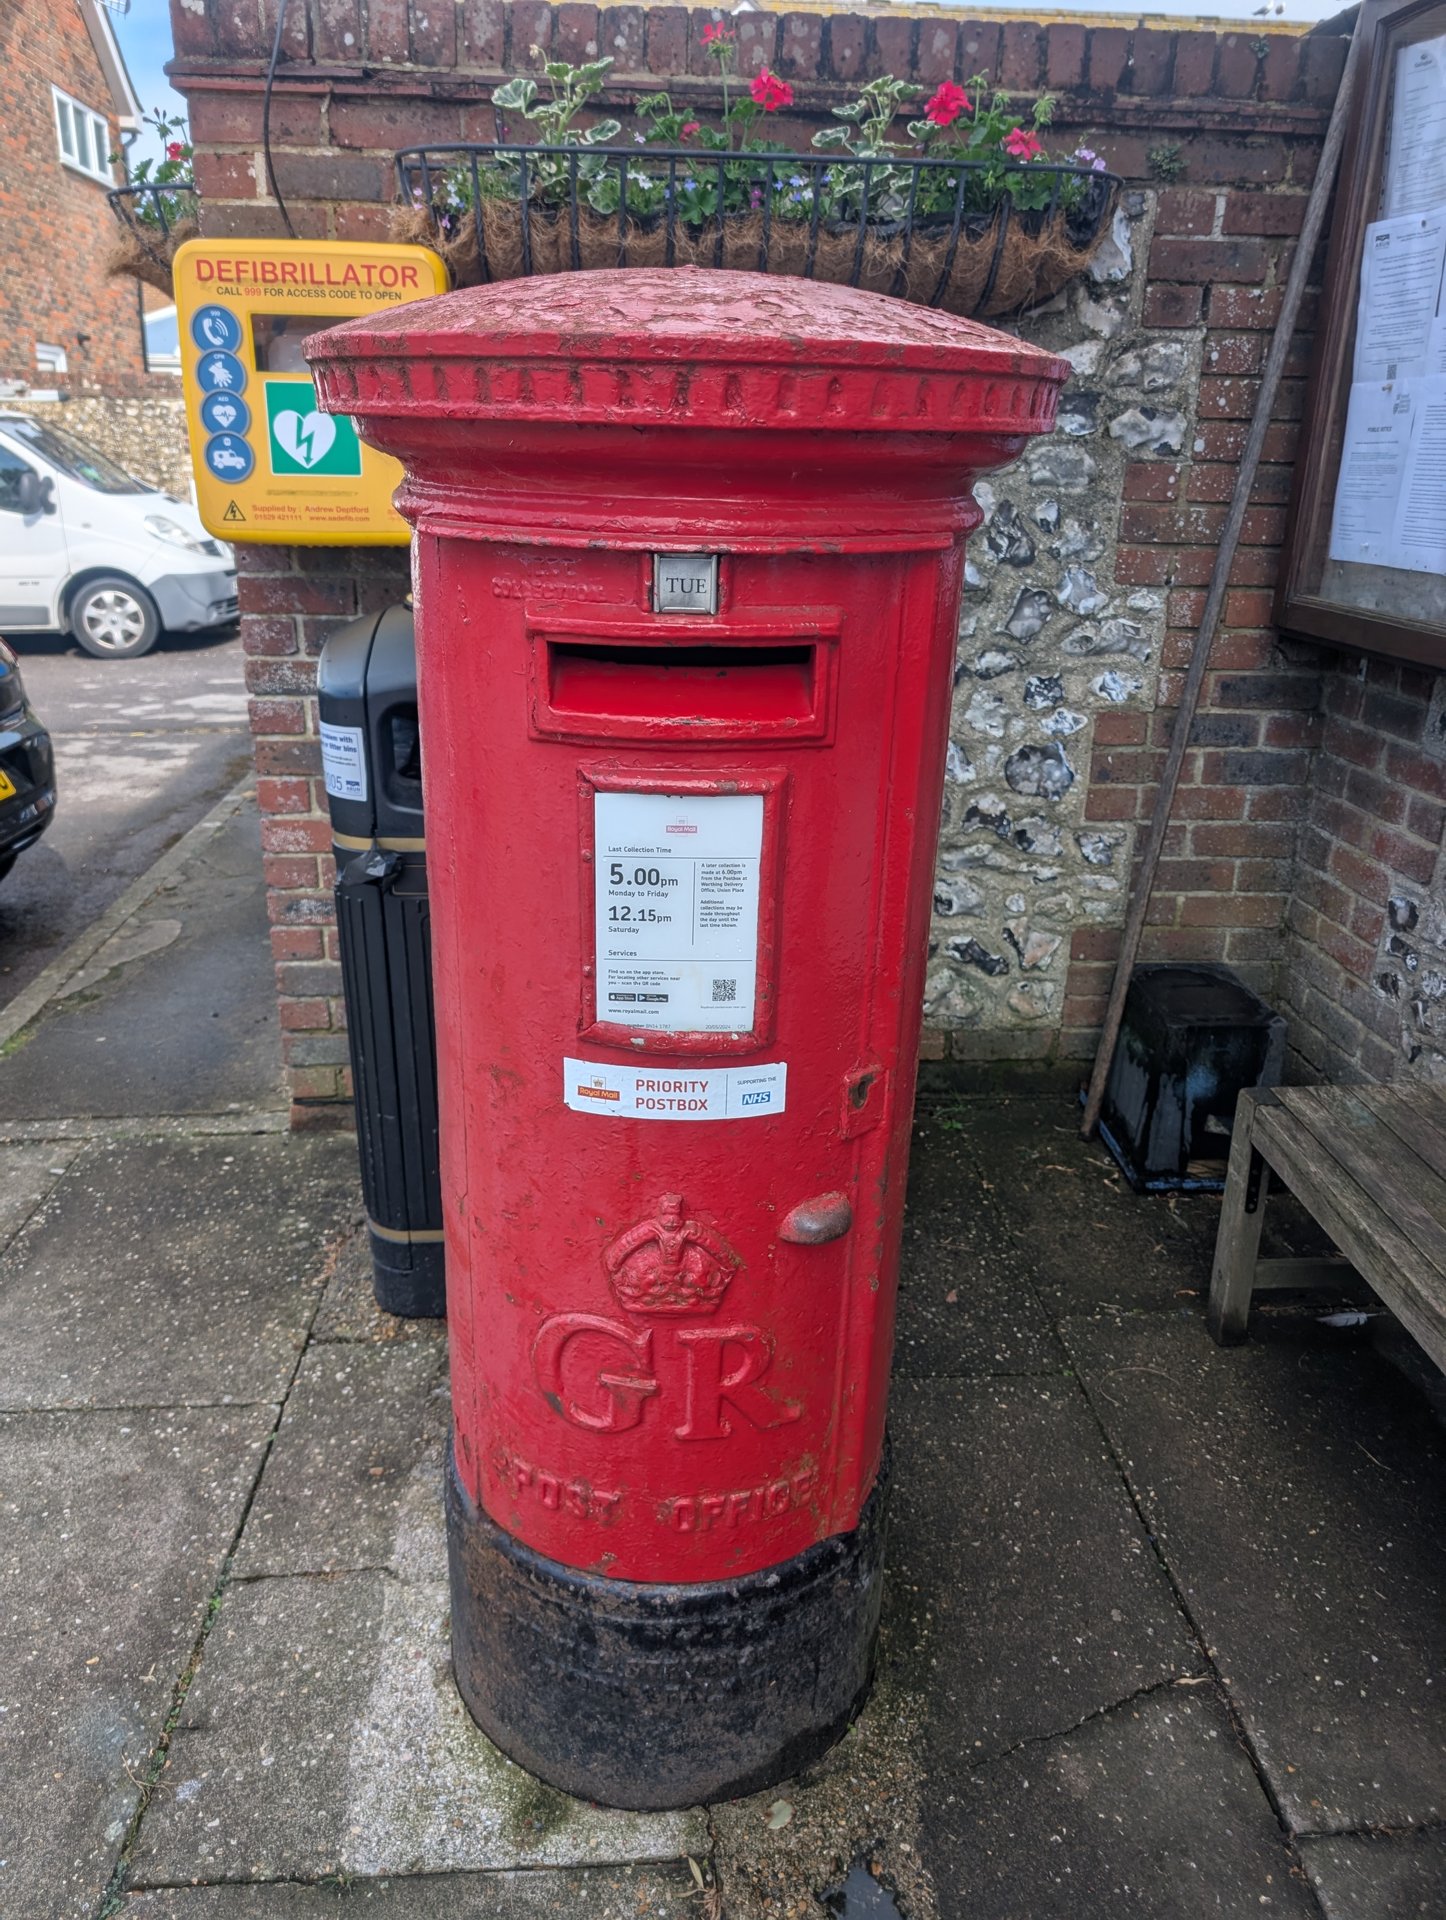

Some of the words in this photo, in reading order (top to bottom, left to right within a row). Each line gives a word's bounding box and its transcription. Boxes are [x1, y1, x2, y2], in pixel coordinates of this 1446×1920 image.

[195, 258, 419, 289] DEFIBRILLATOR
[216, 286, 242, 296] CALL
[244, 287, 262, 297] 999
[264, 288, 284, 297] FOR
[287, 288, 326, 299] ACCESS
[328, 289, 356, 299] CODE
[360, 290, 372, 300] TO
[374, 291, 402, 300] OPEN
[251, 504, 286, 513] Supplied
[287, 505, 297, 513] by
[304, 505, 334, 513] Andrew
[335, 506, 369, 515] Deptford
[665, 577, 707, 594] TUE
[339, 735, 354, 744] with
[343, 743, 357, 753] bins
[609, 863, 678, 888] 5.00pm
[646, 890, 669, 898] Friday
[608, 905, 672, 923] 12.15pm
[608, 926, 640, 934] Saturday
[635, 1079, 709, 1093] PRIORITY
[737, 1078, 767, 1086] SUPPORTING
[579, 1087, 600, 1097] Royal
[601, 1089, 618, 1099] Mail
[743, 1092, 770, 1105] NHS
[635, 1097, 708, 1111] POSTBOX
[513, 1456, 622, 1526] POST
[671, 1467, 818, 1533] OFFICE
